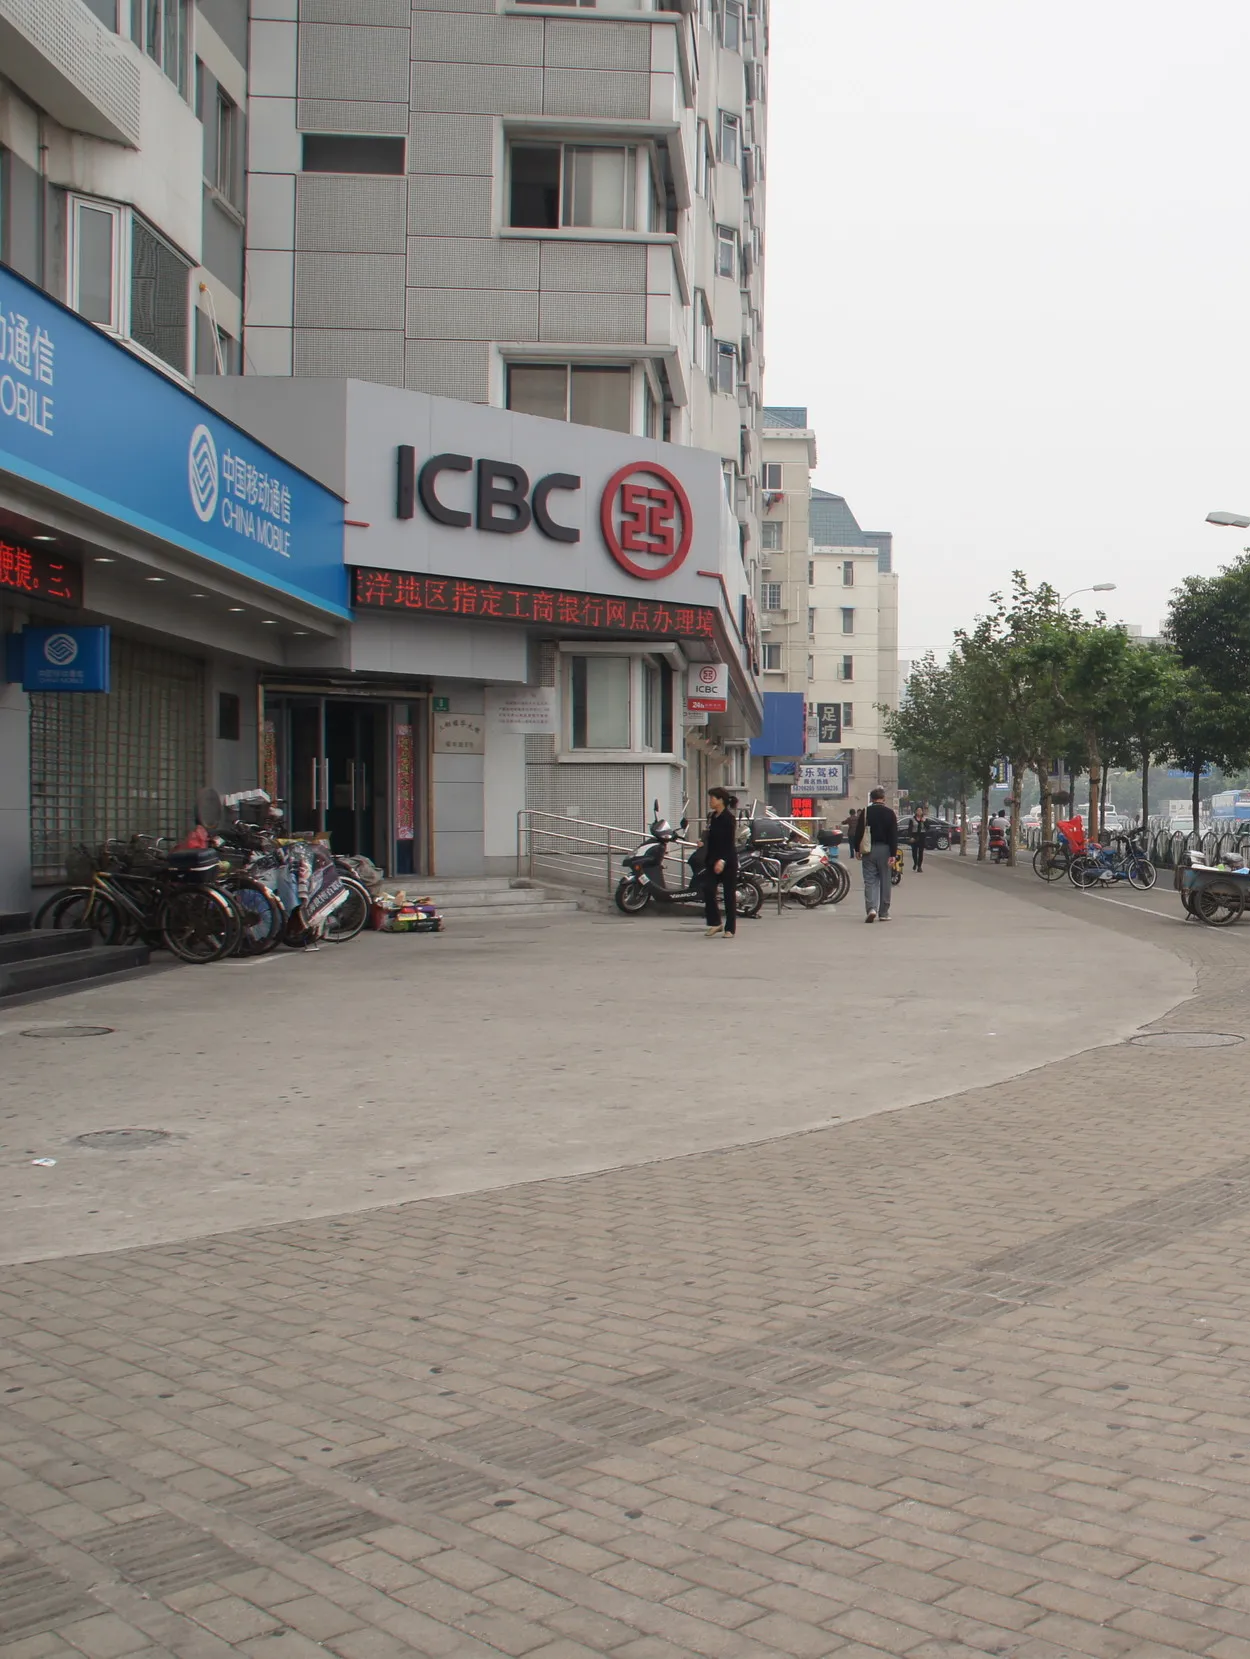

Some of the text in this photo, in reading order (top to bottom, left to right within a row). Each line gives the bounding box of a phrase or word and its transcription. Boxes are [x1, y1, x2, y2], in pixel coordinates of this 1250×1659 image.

[222, 448, 291, 525] 中国移动通信
[396, 444, 581, 543] ICBC
[222, 497, 291, 558] CHINA MOBILE
[356, 568, 714, 638] 洋地区指定工商银行网点办理境
[695, 685, 718, 694] ICBC
[821, 706, 837, 740] 足疗
